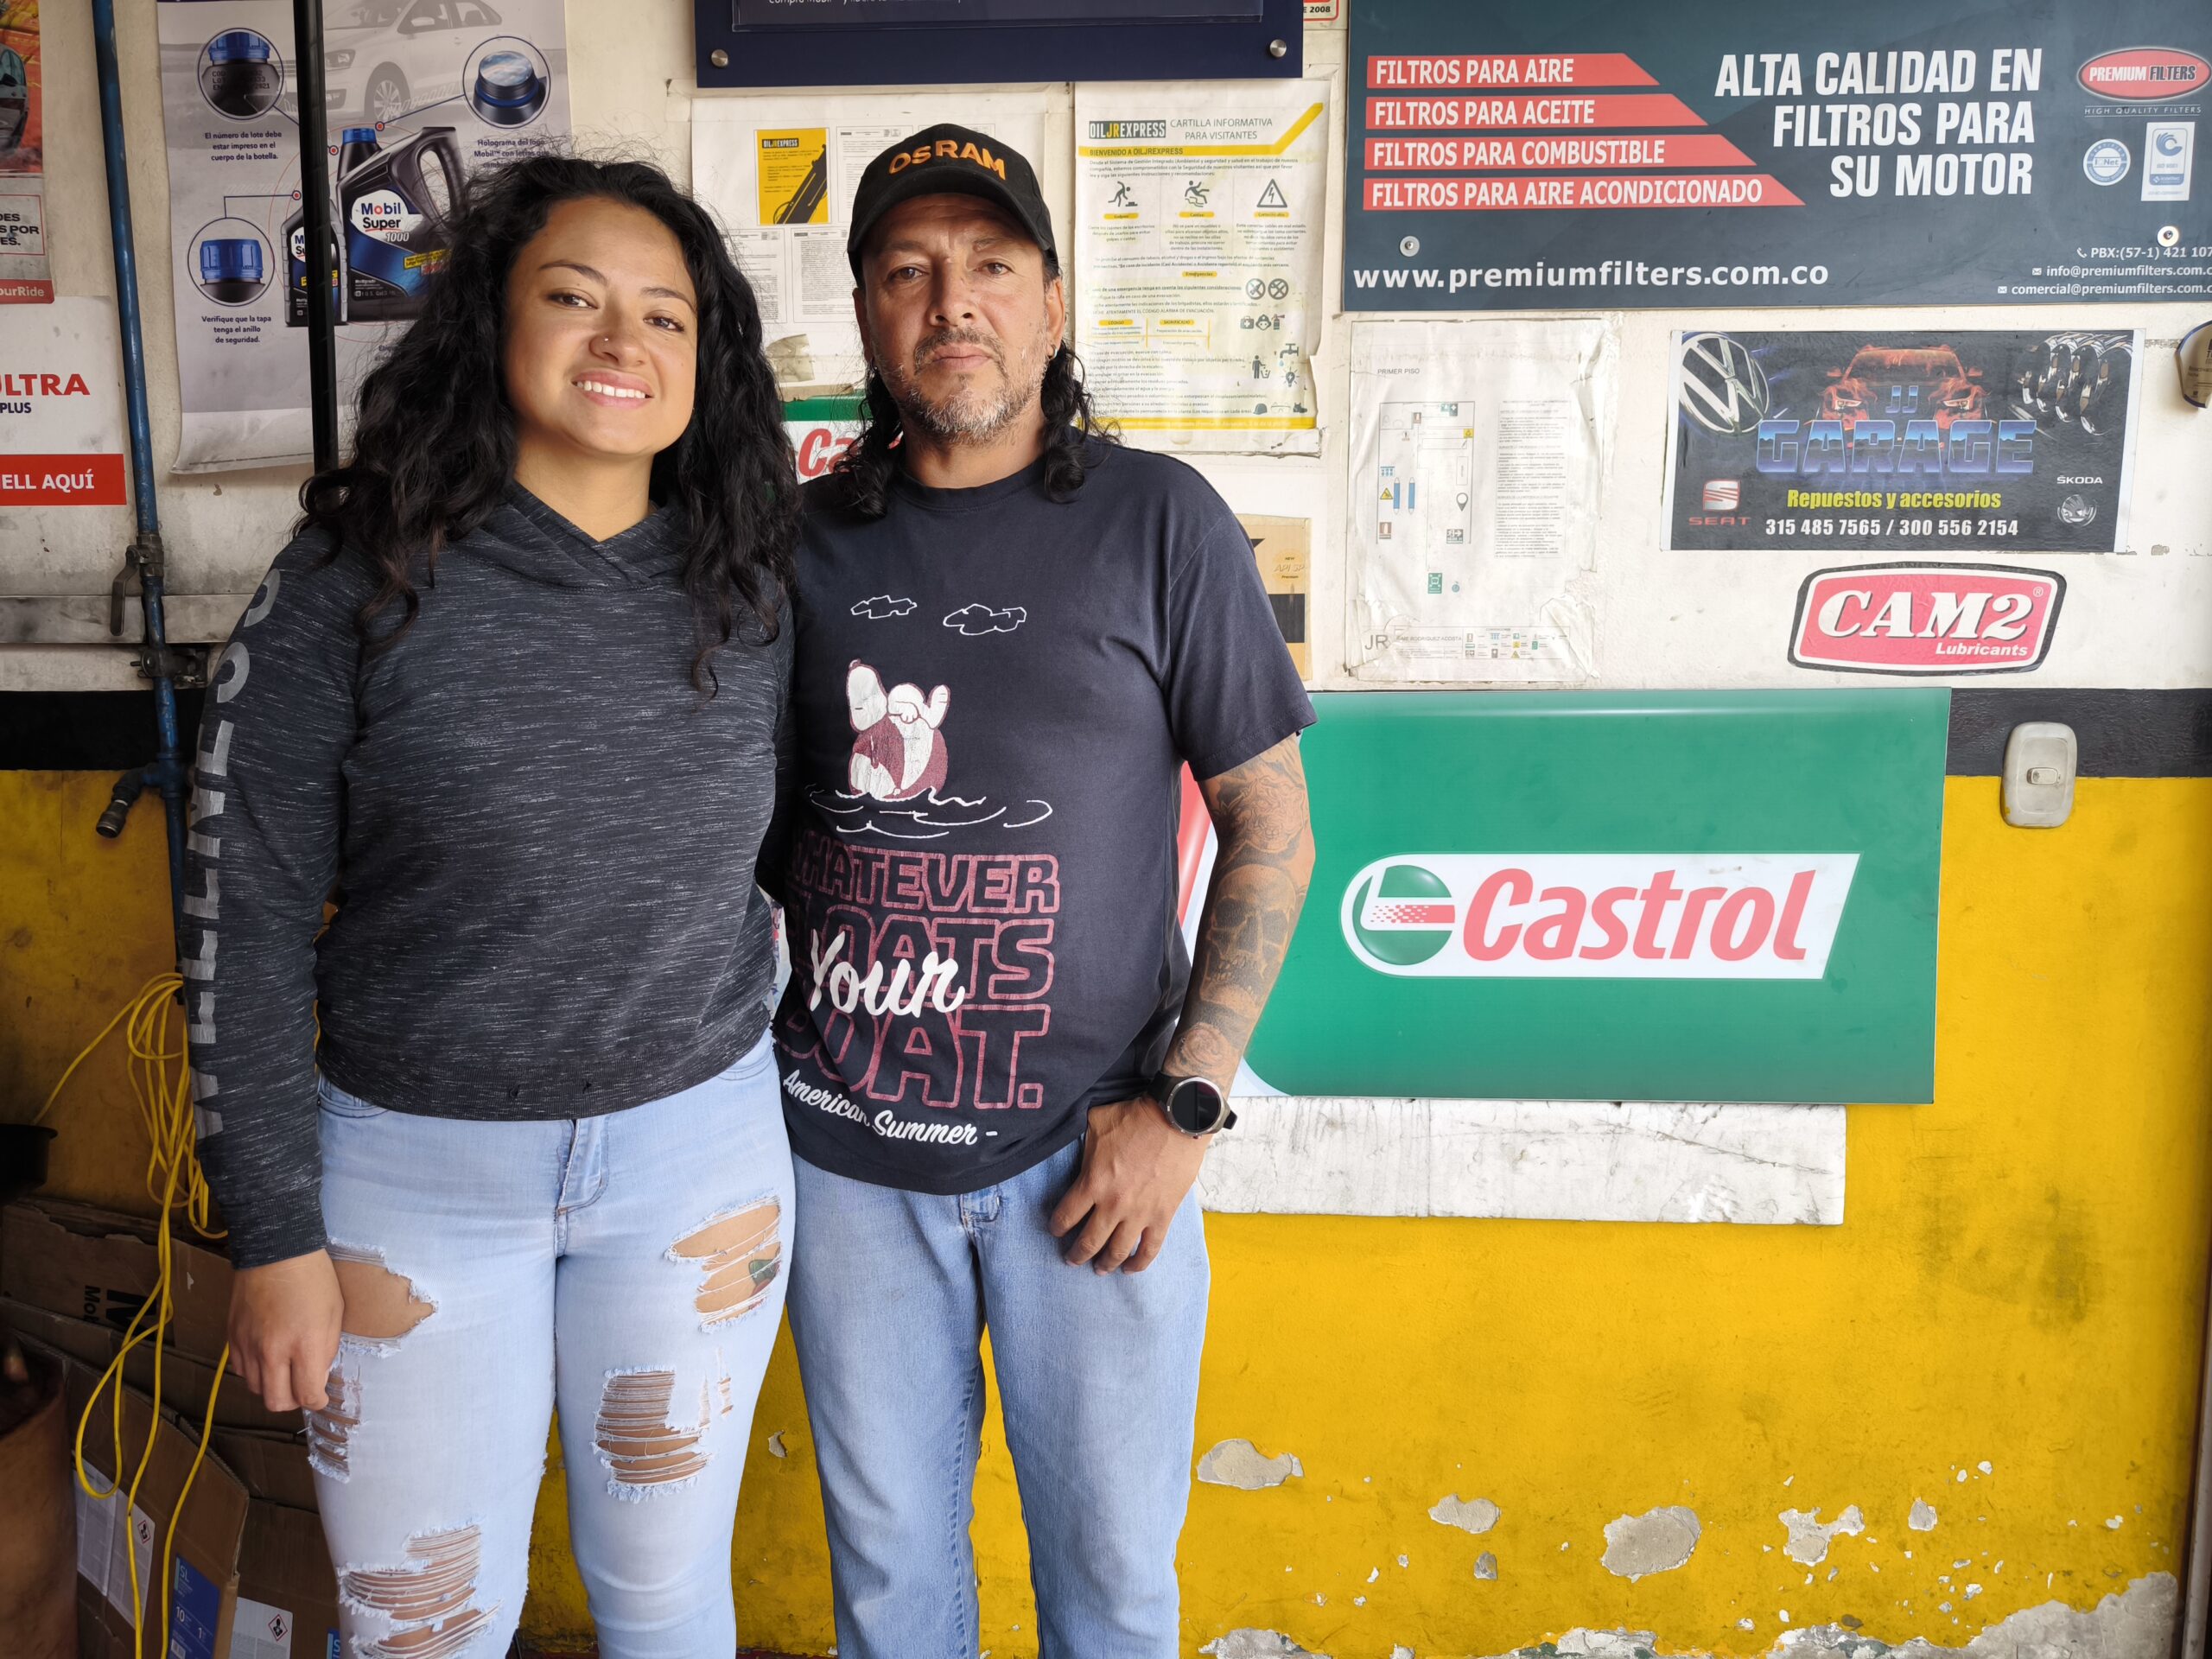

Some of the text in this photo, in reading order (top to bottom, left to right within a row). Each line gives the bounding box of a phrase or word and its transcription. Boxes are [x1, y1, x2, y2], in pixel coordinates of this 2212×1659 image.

[1376, 58, 1574, 85] FILTROS PARA AIRE
[1714, 48, 2043, 97] ALTA CALIDAD EN
[2089, 65, 2197, 82] PREMIUM FILTERS
[1170, 118, 1273, 128] CARTILLA INFORMATIVA
[1375, 99, 1595, 126] FILTROS PARA ACEITE
[1090, 122, 1166, 138] OILJREXPRESS
[1773, 100, 2035, 148] FILTROS PARA
[1210, 131, 1257, 140] VISITANTES
[231, 142, 258, 151] impreso
[1373, 139, 1665, 167] FILTROS PARA COMBUSTIBLE
[890, 139, 1007, 181] OSRAM
[2094, 157, 2119, 166] INet
[1829, 152, 2033, 198] SU MOTOR
[1372, 178, 1763, 207] FILTROS PARA AIRE ACONDICIONADO
[361, 202, 401, 215] Mobil
[10, 226, 40, 235] POR
[363, 218, 401, 231] Super
[386, 232, 410, 242] 1000
[2163, 246, 2186, 257] 421
[1353, 261, 1829, 293] www.premiumfilters.com.co
[201, 315, 234, 324] Verifique
[0, 373, 91, 396] LTRA
[0, 402, 32, 414] PLUS
[1885, 385, 1918, 414] JJ
[1756, 419, 2037, 474] GARAGE
[41, 468, 95, 493] AQUÍ
[2056, 474, 2103, 485] ŠKODA
[1787, 489, 2001, 510] Repuestos y accesorios
[1688, 517, 1751, 526] SEAT
[1765, 518, 2018, 536] 315 485 7565 / 300 556 2154
[1818, 589, 2034, 641] CAM2
[1364, 634, 1389, 650] JR
[1936, 642, 2028, 657] Lubricants
[1463, 868, 1816, 962] Castrol
[795, 903, 1054, 1000] OATS
[810, 928, 966, 1018] Your
[783, 1069, 870, 1127] American
[872, 1109, 978, 1146] Summer
